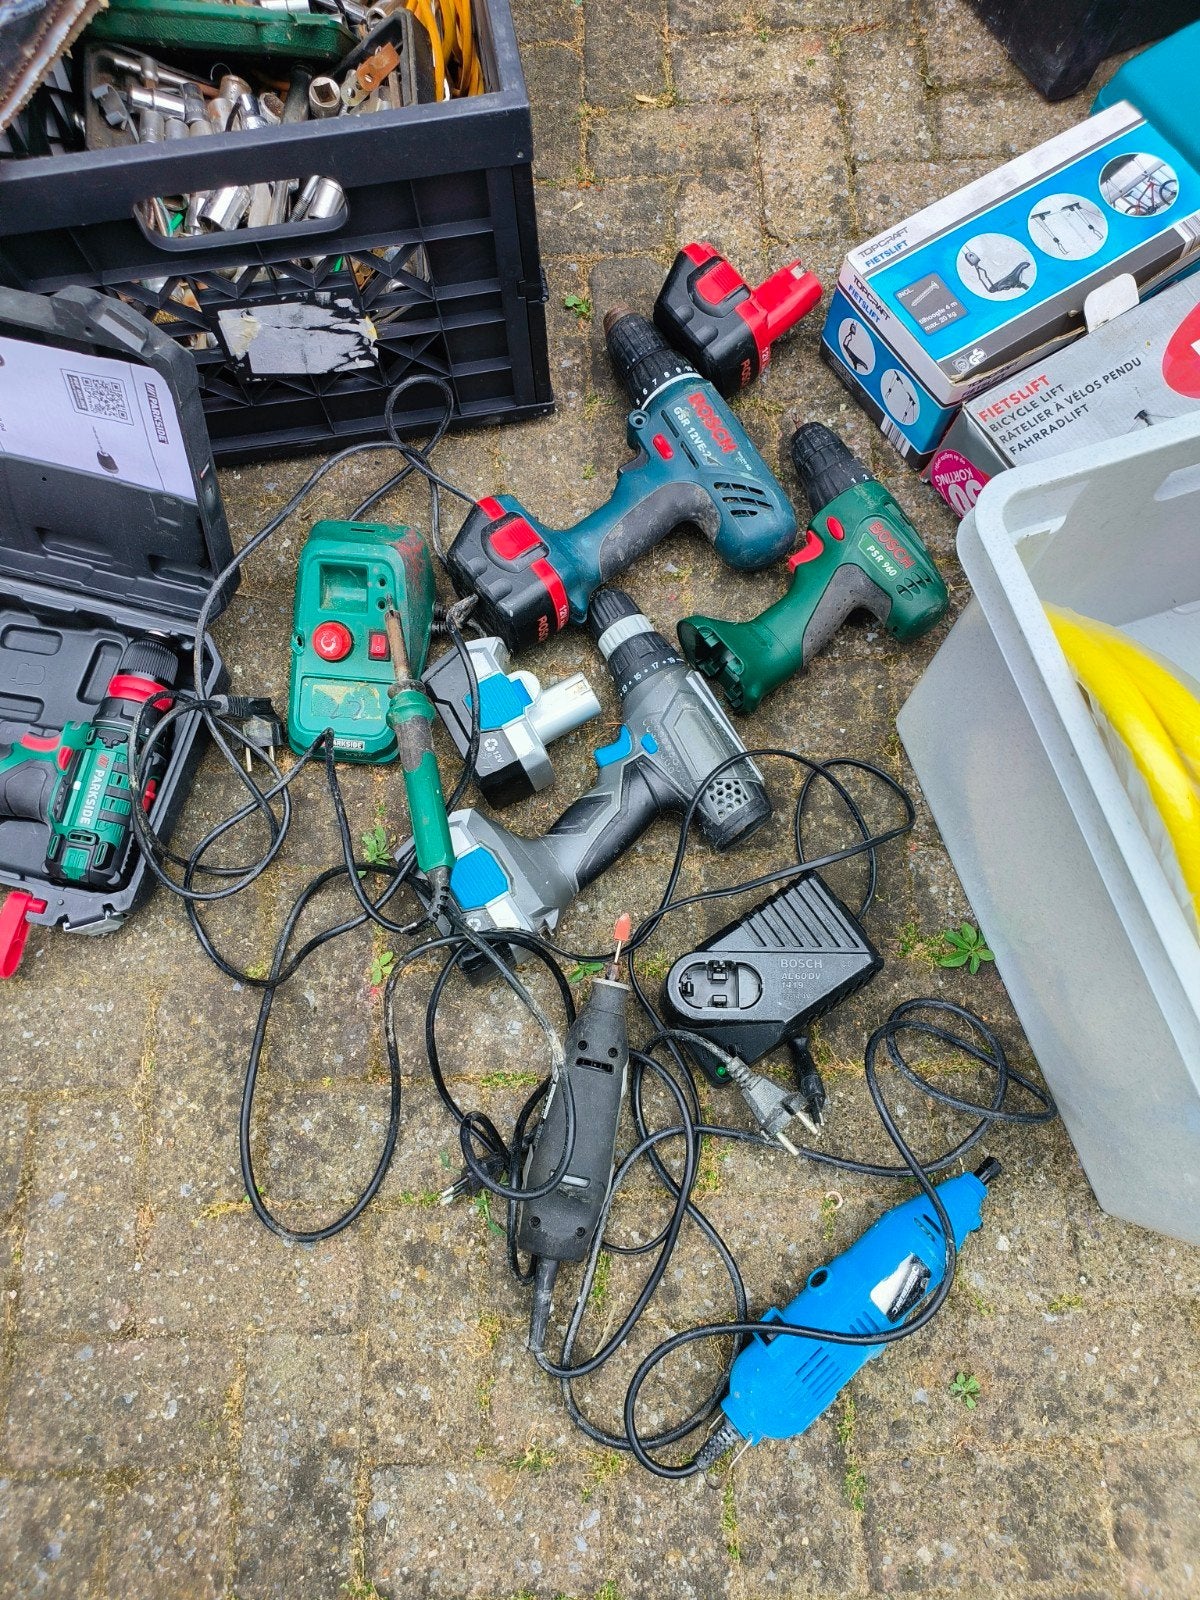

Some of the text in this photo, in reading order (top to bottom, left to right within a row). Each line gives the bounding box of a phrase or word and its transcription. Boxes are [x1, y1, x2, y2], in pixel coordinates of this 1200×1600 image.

[858, 226, 908, 258] TOPCRAFT
[865, 240, 908, 267] FIETSLIFT
[848, 284, 880, 322] FIETSLIFT
[854, 274, 890, 320] TOPCRAFT
[652, 378, 658, 386] 7
[977, 375, 1050, 423] FIETSLIFT
[999, 357, 1142, 444] RÂTELIER À VÉLOS PENDU
[150, 394, 168, 443] PARKSIDE
[673, 406, 691, 427] GSR
[688, 391, 738, 453] BOSCH
[989, 384, 1065, 433] BICYCLE LIFT
[1009, 404, 1089, 455] FAHRRADLIFT
[934, 467, 974, 486] KORTING
[866, 545, 897, 577] PSR 960
[868, 521, 916, 569] BOSCH
[651, 661, 659, 670] 17
[332, 739, 364, 750] ARKSIDE
[80, 769, 106, 825] PARKSIDE
[780, 958, 823, 969] BOSCH
